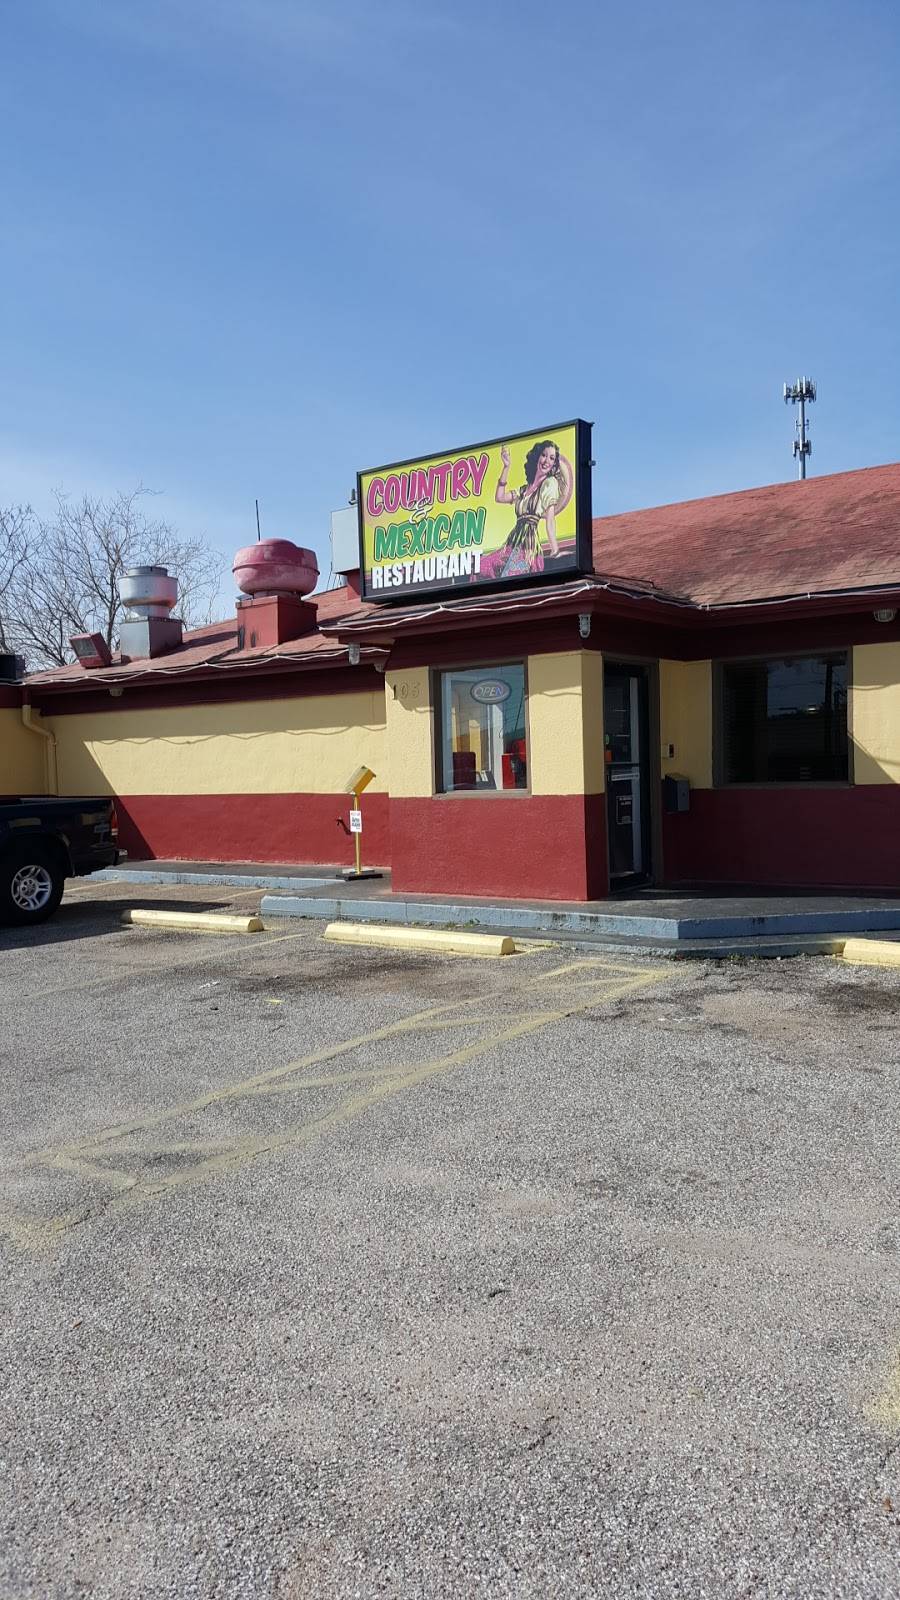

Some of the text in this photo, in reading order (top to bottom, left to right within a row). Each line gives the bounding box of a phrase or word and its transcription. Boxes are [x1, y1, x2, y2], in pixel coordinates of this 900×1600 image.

[367, 453, 489, 516] COUNTRY
[408, 497, 433, 524] &
[374, 507, 486, 562] MEXICAN
[371, 550, 484, 589] RESTAURANT
[473, 686, 505, 697] OPEN
